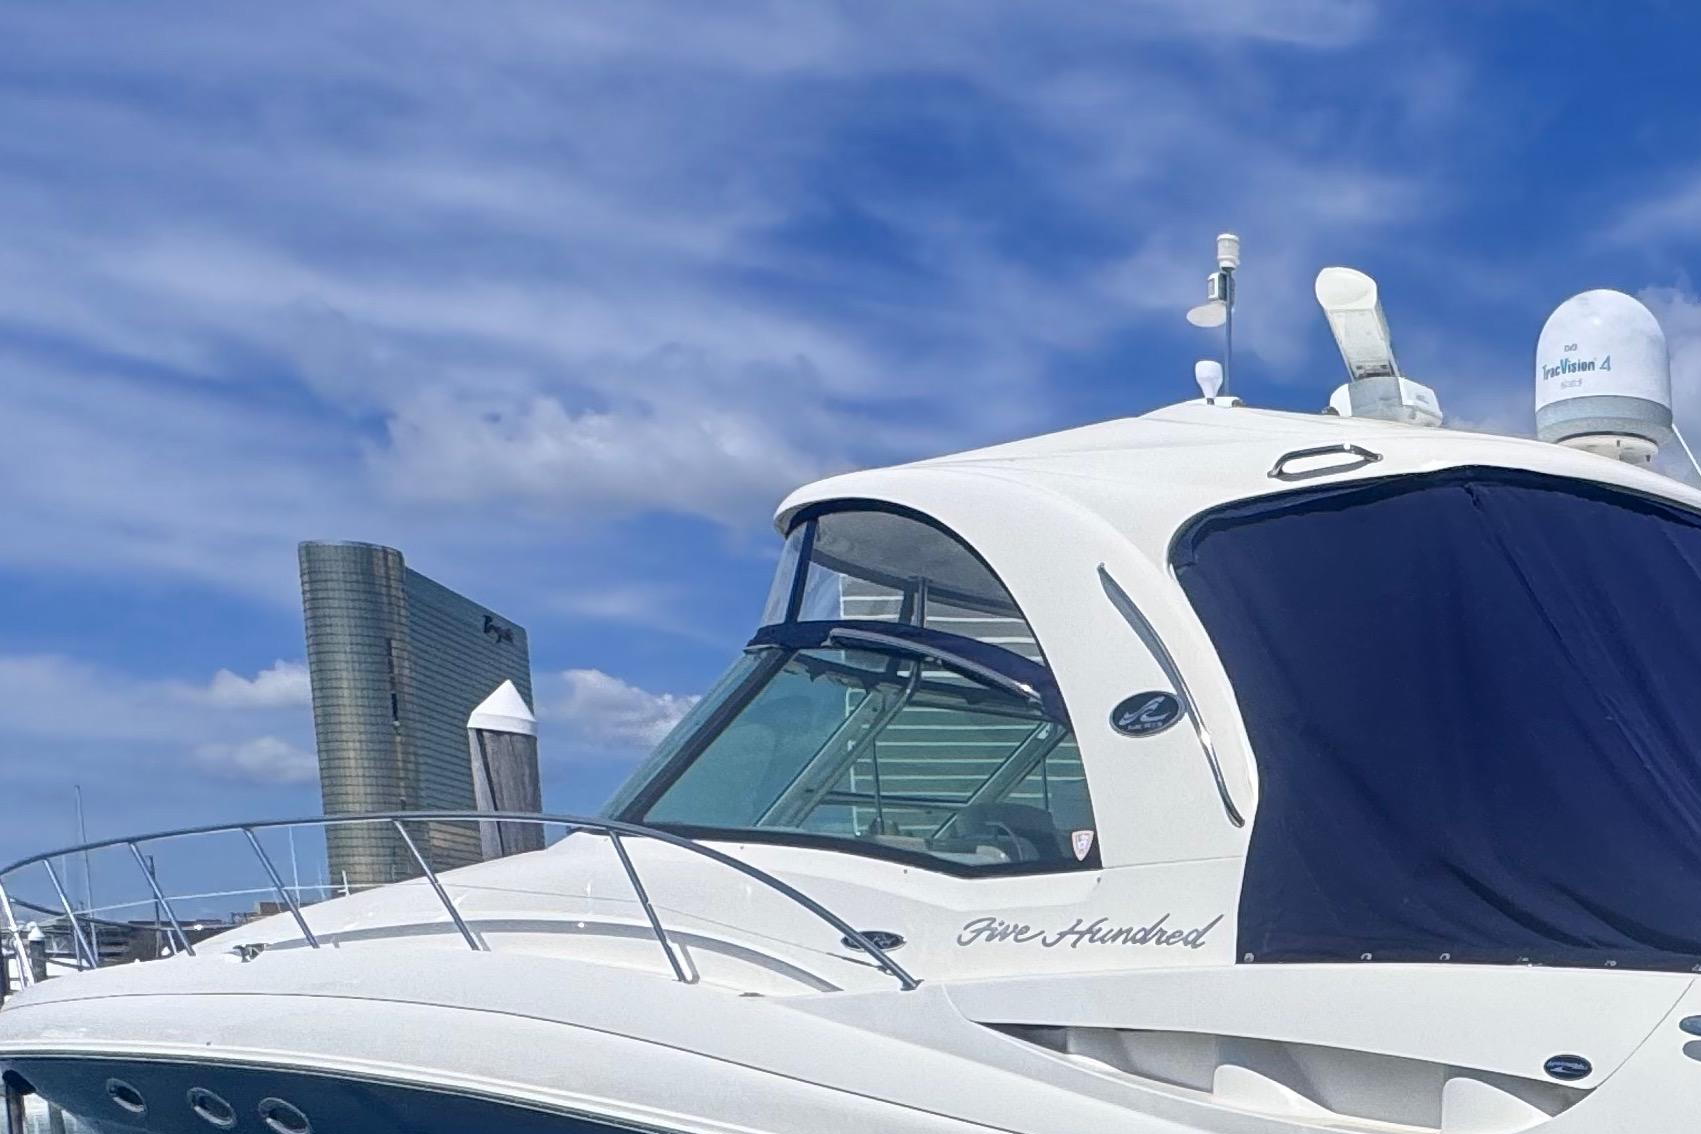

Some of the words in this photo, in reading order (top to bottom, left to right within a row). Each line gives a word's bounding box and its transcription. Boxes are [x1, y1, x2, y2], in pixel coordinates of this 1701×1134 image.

[1542, 358, 1596, 381] TracVision
[1599, 355, 1612, 372] 4
[956, 916, 1045, 947] Five
[1041, 912, 1225, 949] Hundred
